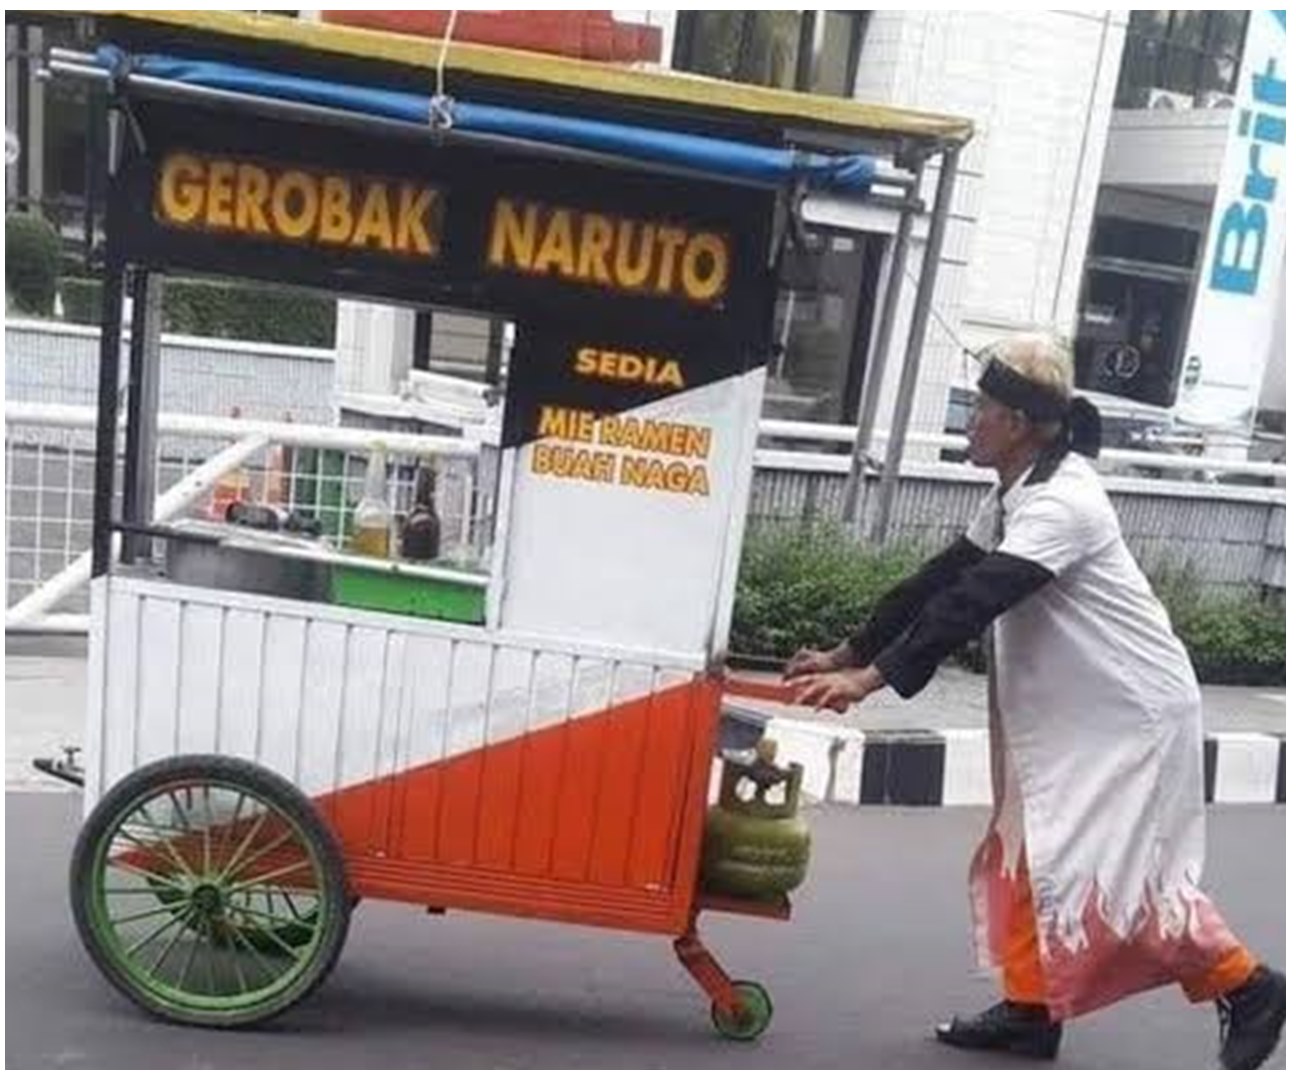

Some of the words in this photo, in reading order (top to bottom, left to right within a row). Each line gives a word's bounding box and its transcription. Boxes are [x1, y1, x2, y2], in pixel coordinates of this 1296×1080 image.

[160, 153, 439, 256] GEROBAK
[487, 197, 729, 301] NARUTO
[574, 347, 685, 388] SEDIA
[538, 406, 594, 443] MIE
[599, 414, 713, 460] RAMEN
[532, 443, 616, 484] BUAH
[619, 454, 710, 497] NAGA
